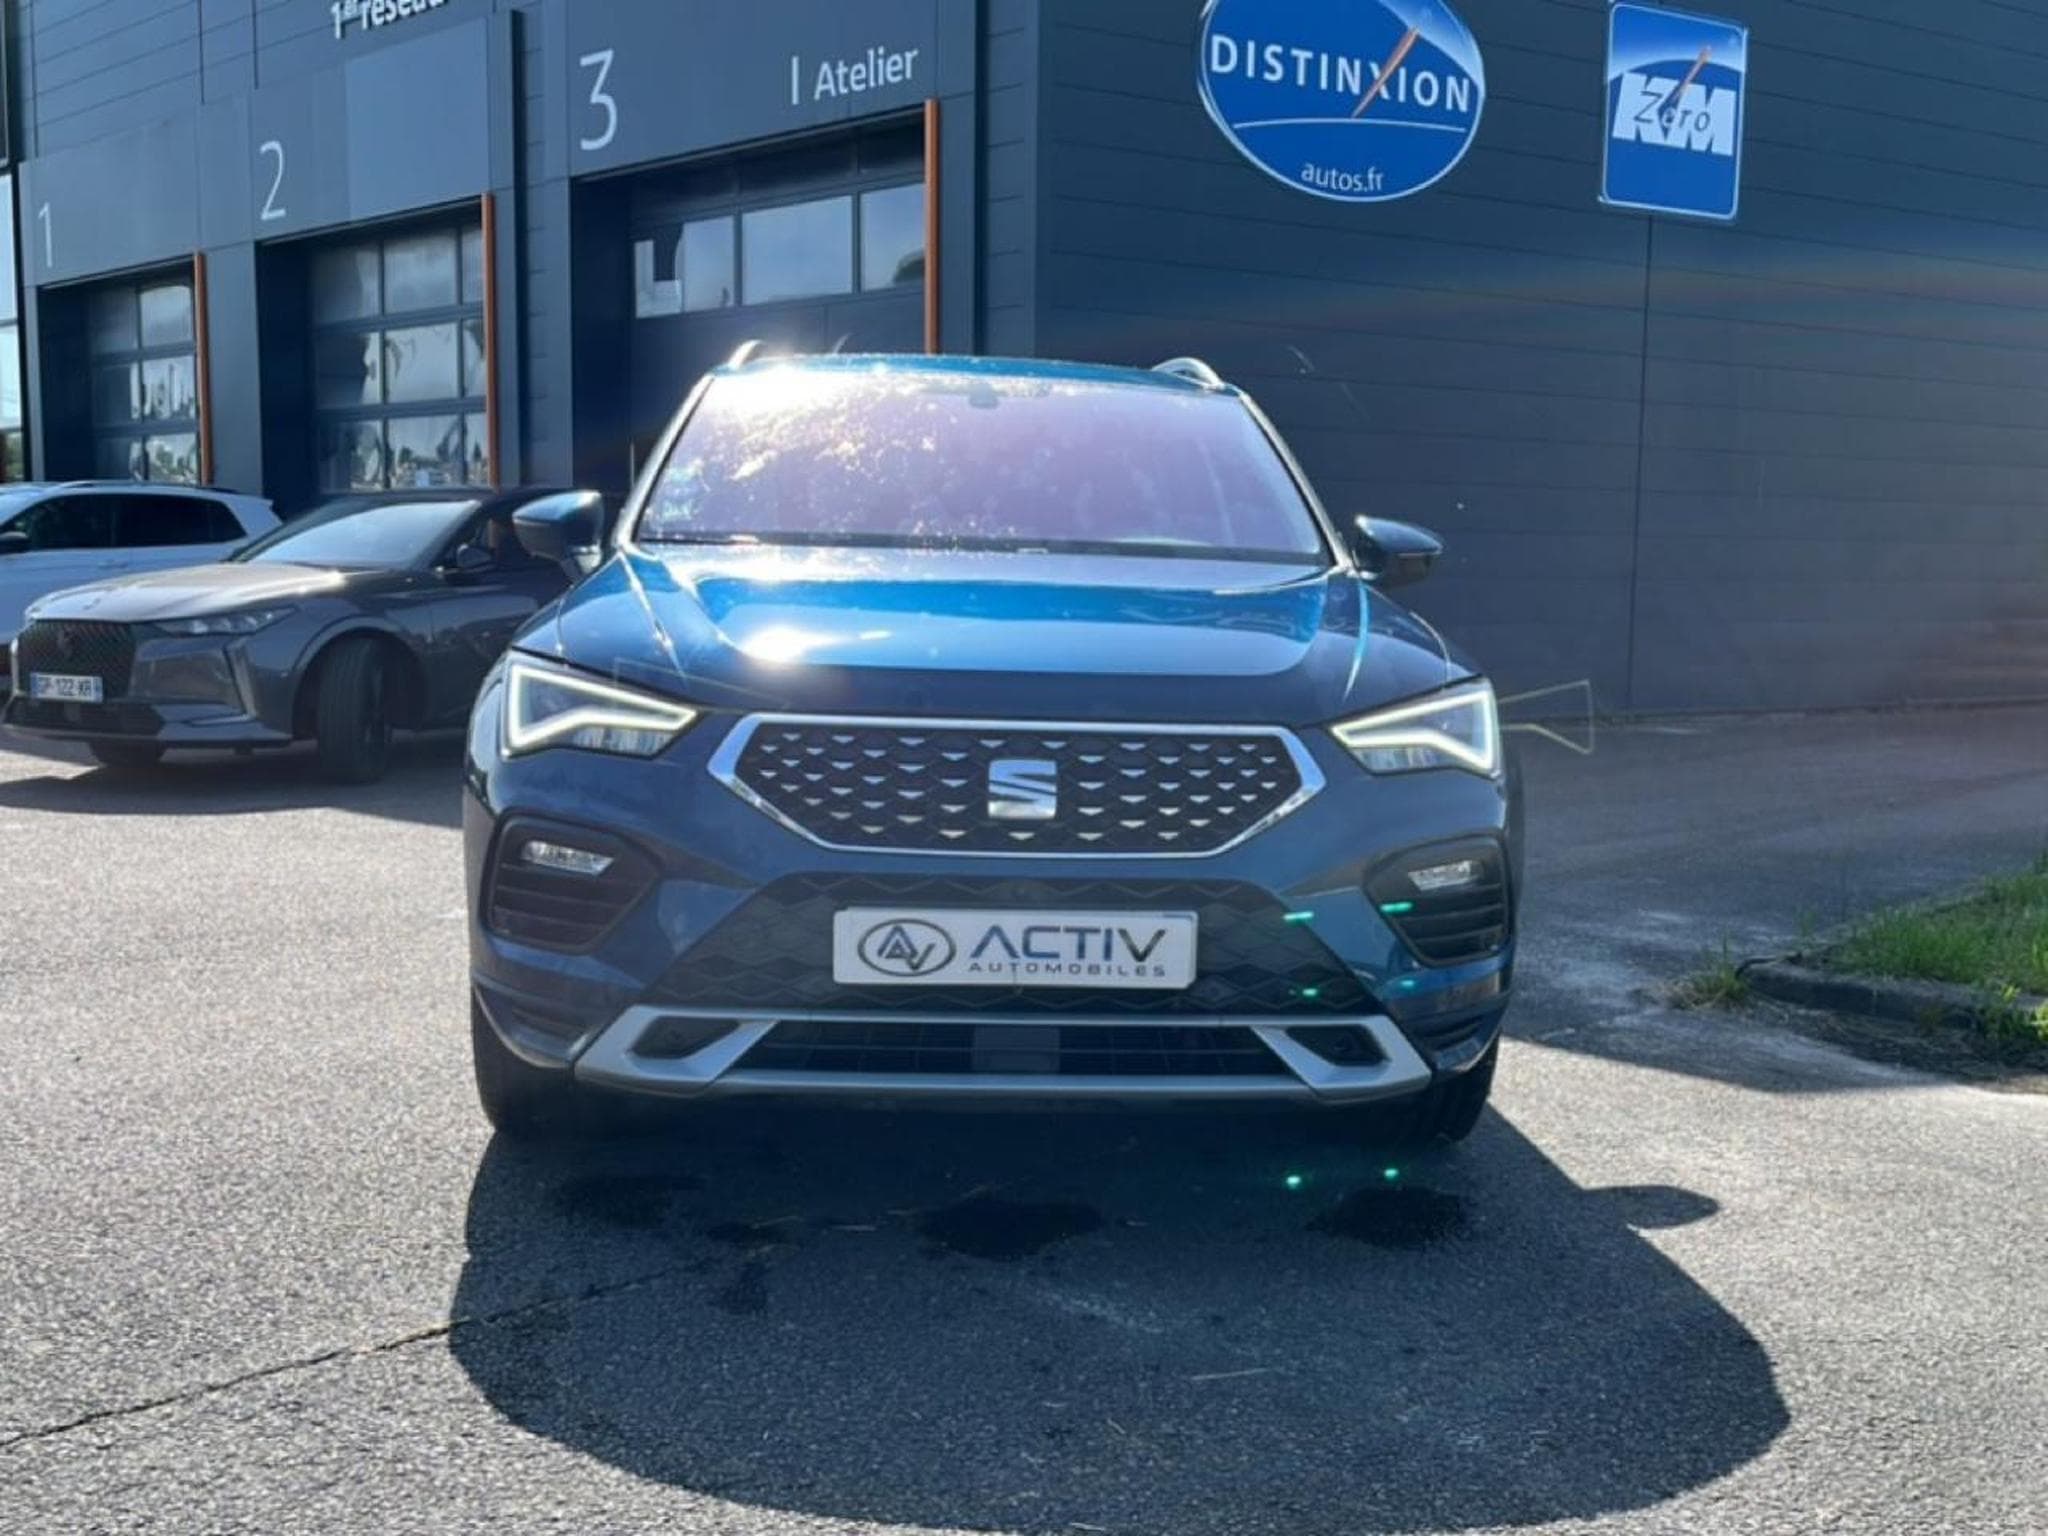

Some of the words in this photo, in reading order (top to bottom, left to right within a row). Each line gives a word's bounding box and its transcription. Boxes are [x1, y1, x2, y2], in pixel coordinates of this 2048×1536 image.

[579, 48, 618, 151] 3
[814, 45, 920, 100] Atelier
[1210, 34, 1470, 113] DISTINXION
[1612, 71, 1737, 157] KM
[259, 140, 287, 222] 2
[1301, 162, 1384, 192] autos.fr
[37, 201, 54, 269] 1
[968, 961, 1166, 978] AUTOMOBILES
[969, 924, 1167, 963] ACTIV
